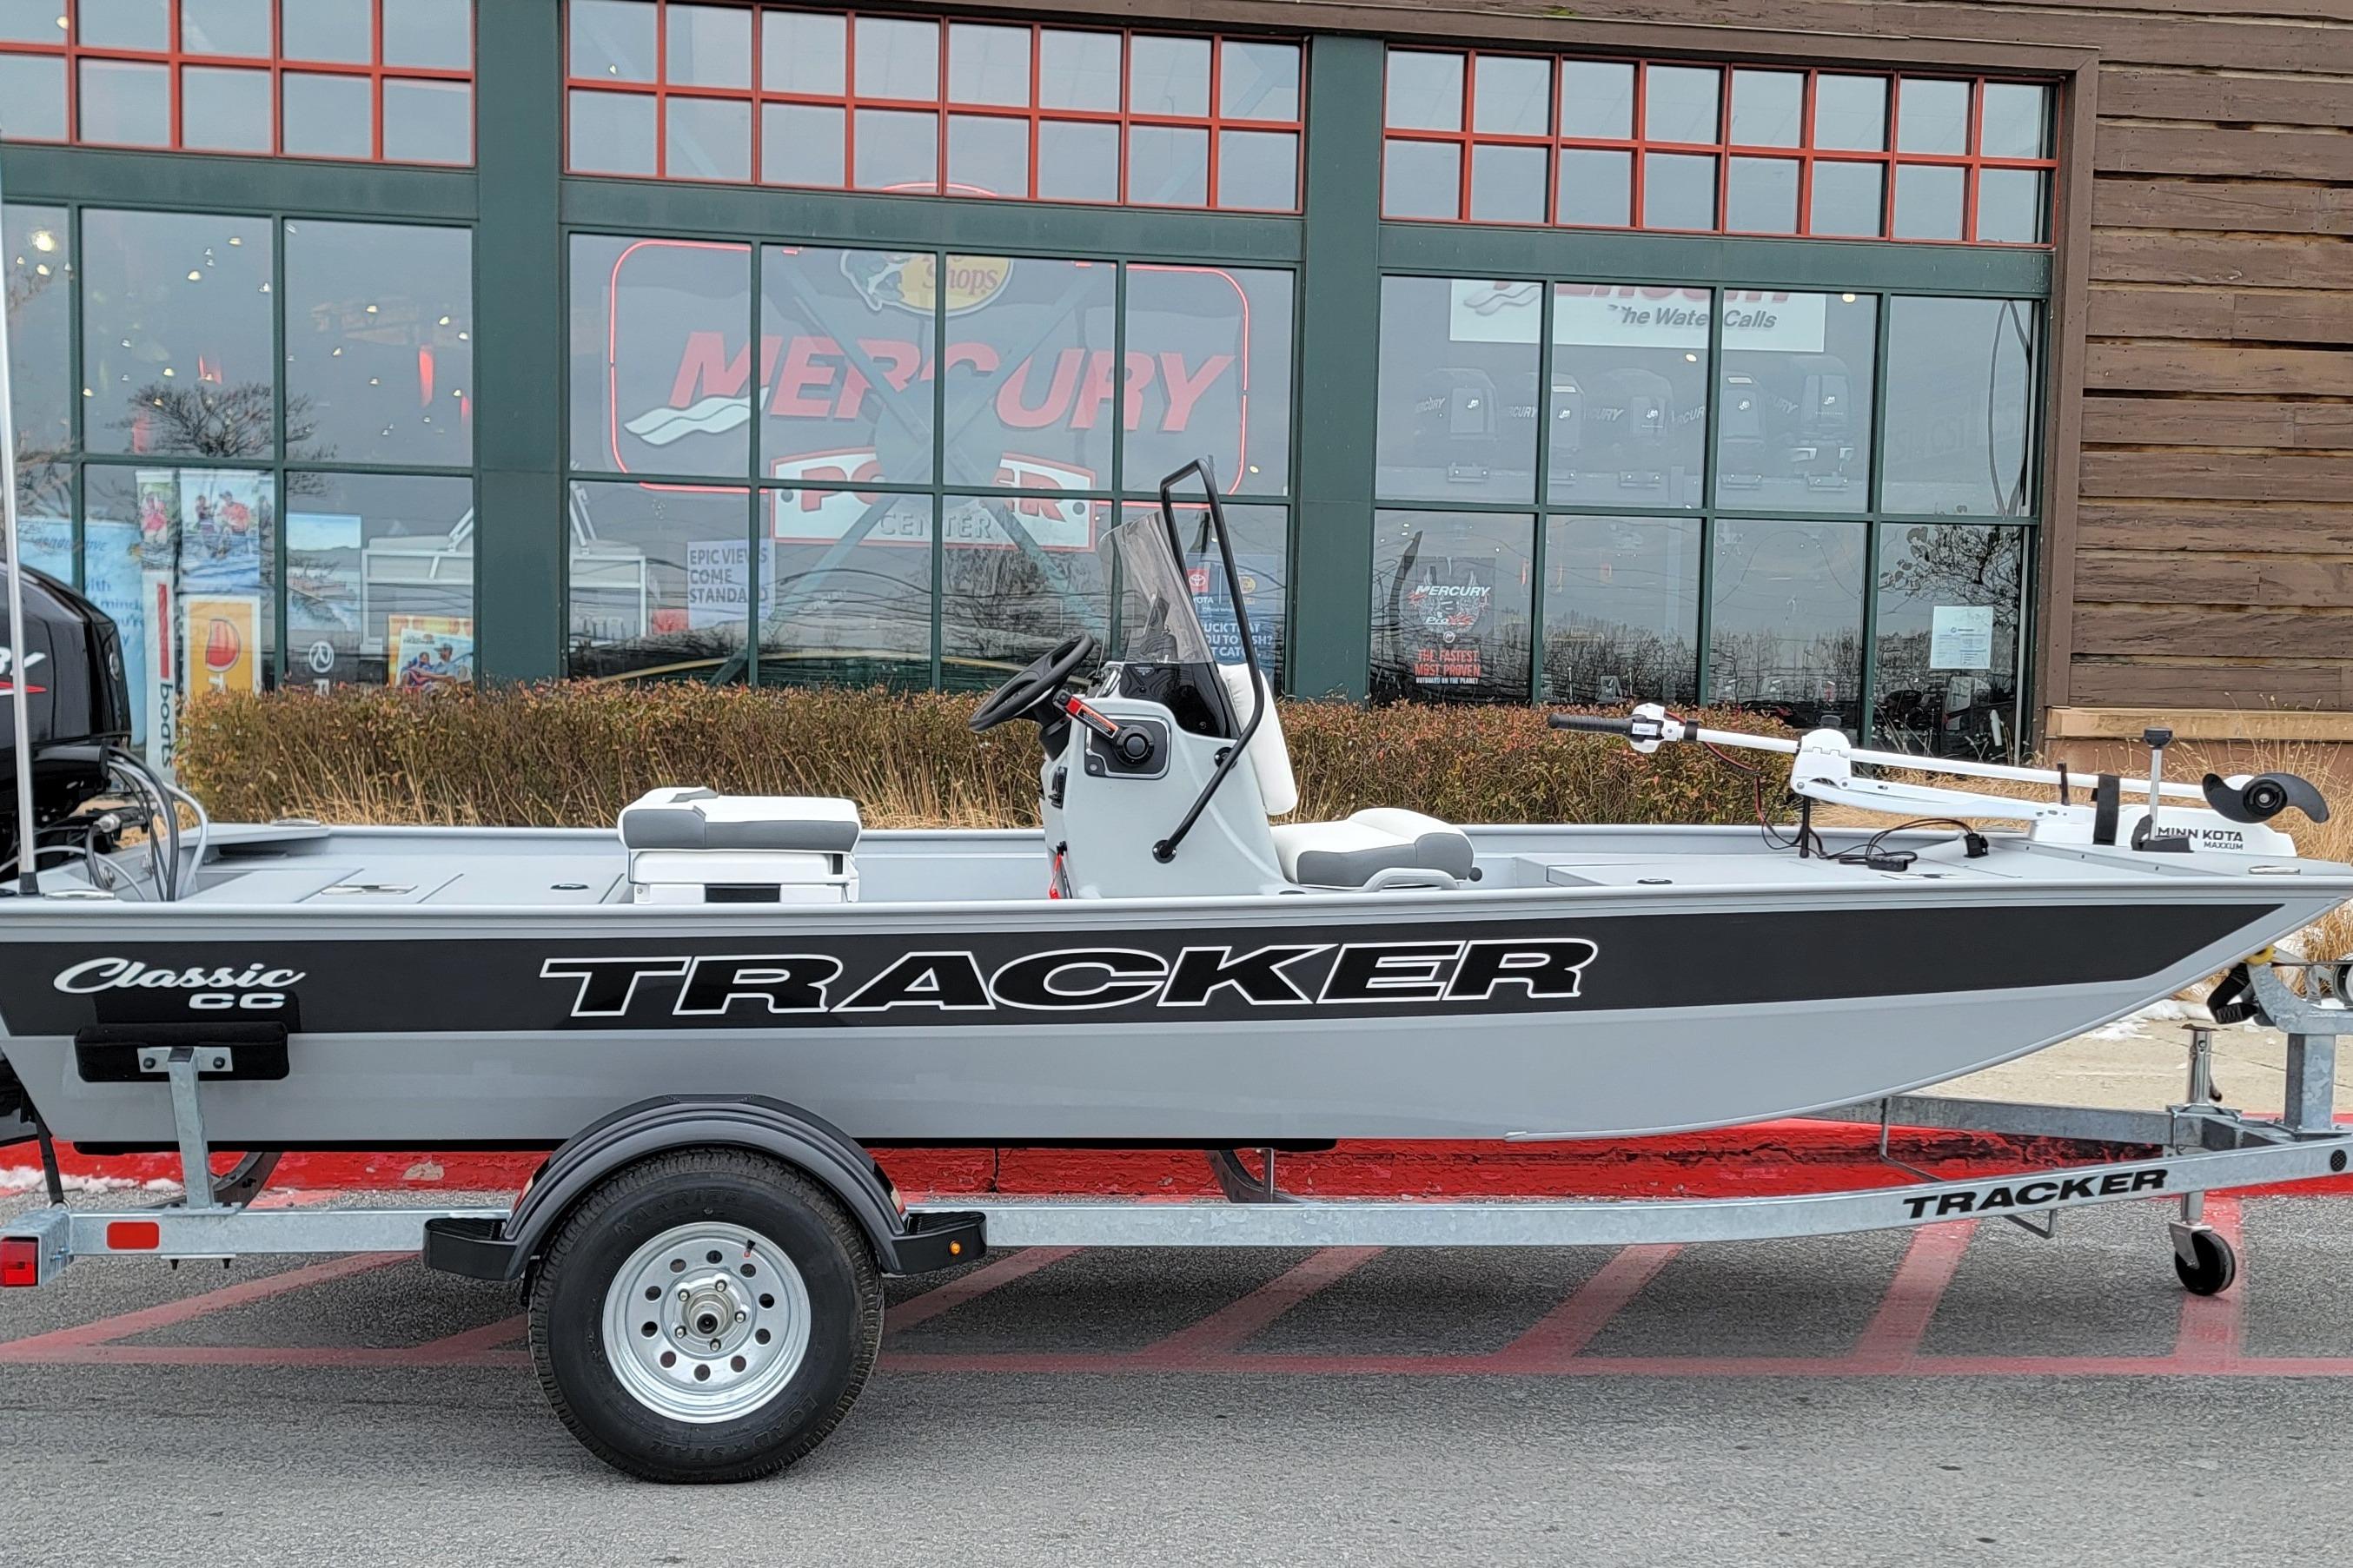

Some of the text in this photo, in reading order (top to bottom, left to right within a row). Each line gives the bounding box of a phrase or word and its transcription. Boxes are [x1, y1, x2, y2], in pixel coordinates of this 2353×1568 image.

[1655, 308, 1710, 327] Wate
[1724, 309, 1778, 328] Calls
[689, 549, 719, 565] EPIC
[689, 568, 732, 585] COME
[689, 586, 769, 604] STANDAD
[1415, 585, 1492, 597] MERCURY
[1223, 635, 1239, 645] TO
[1418, 649, 1435, 662] THE
[1414, 663, 1481, 677] MOST PROVEN
[160, 683, 175, 768] boats
[2157, 826, 2244, 842] MINN KOTA
[2204, 841, 2244, 850] MAXXUM
[52, 956, 307, 996] Classic
[539, 937, 1601, 1019] TRACKER
[189, 991, 286, 1010] CC
[1903, 1168, 2169, 1220] TRACKER
